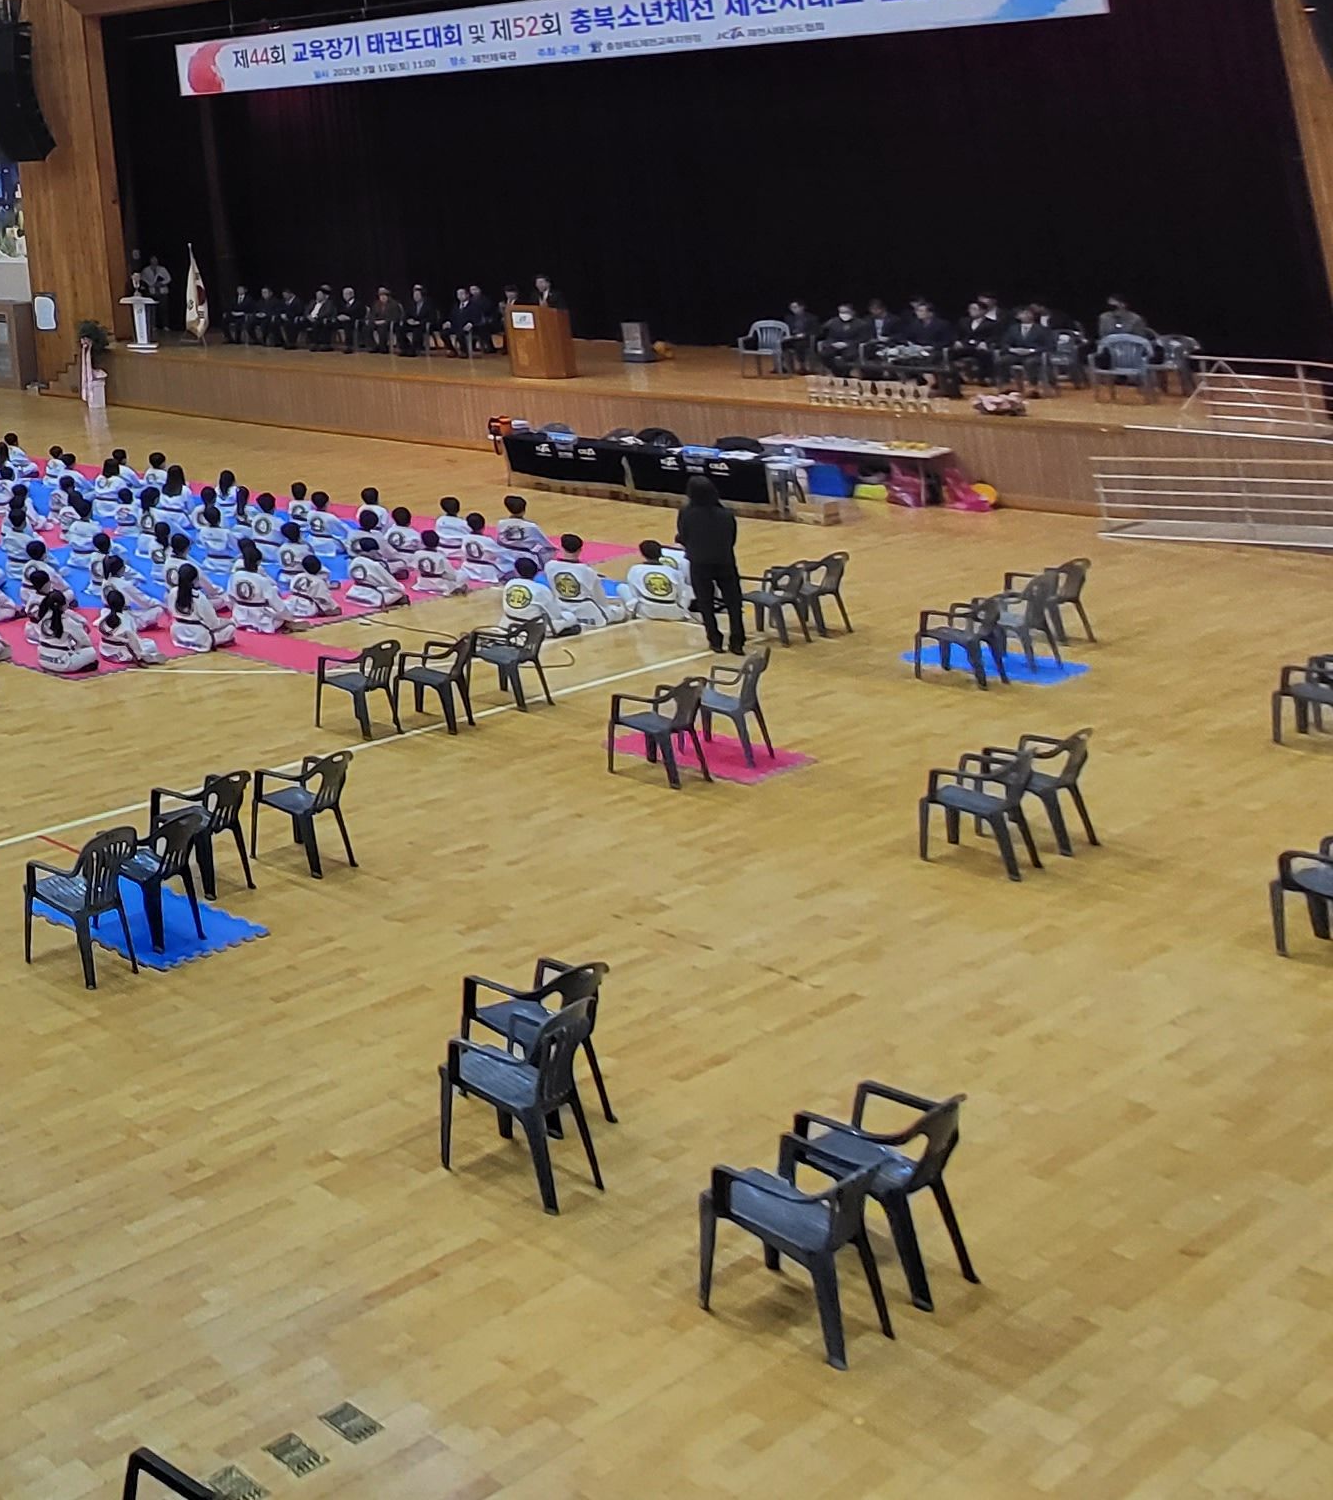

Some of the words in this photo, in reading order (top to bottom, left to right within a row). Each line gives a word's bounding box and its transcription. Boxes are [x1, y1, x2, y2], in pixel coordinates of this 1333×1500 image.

[233, 44, 286, 68] 제44회
[292, 36, 361, 62] 교육장기
[366, 23, 463, 55] 태권도대회
[468, 24, 485, 44] 및
[490, 11, 562, 42] 제52회
